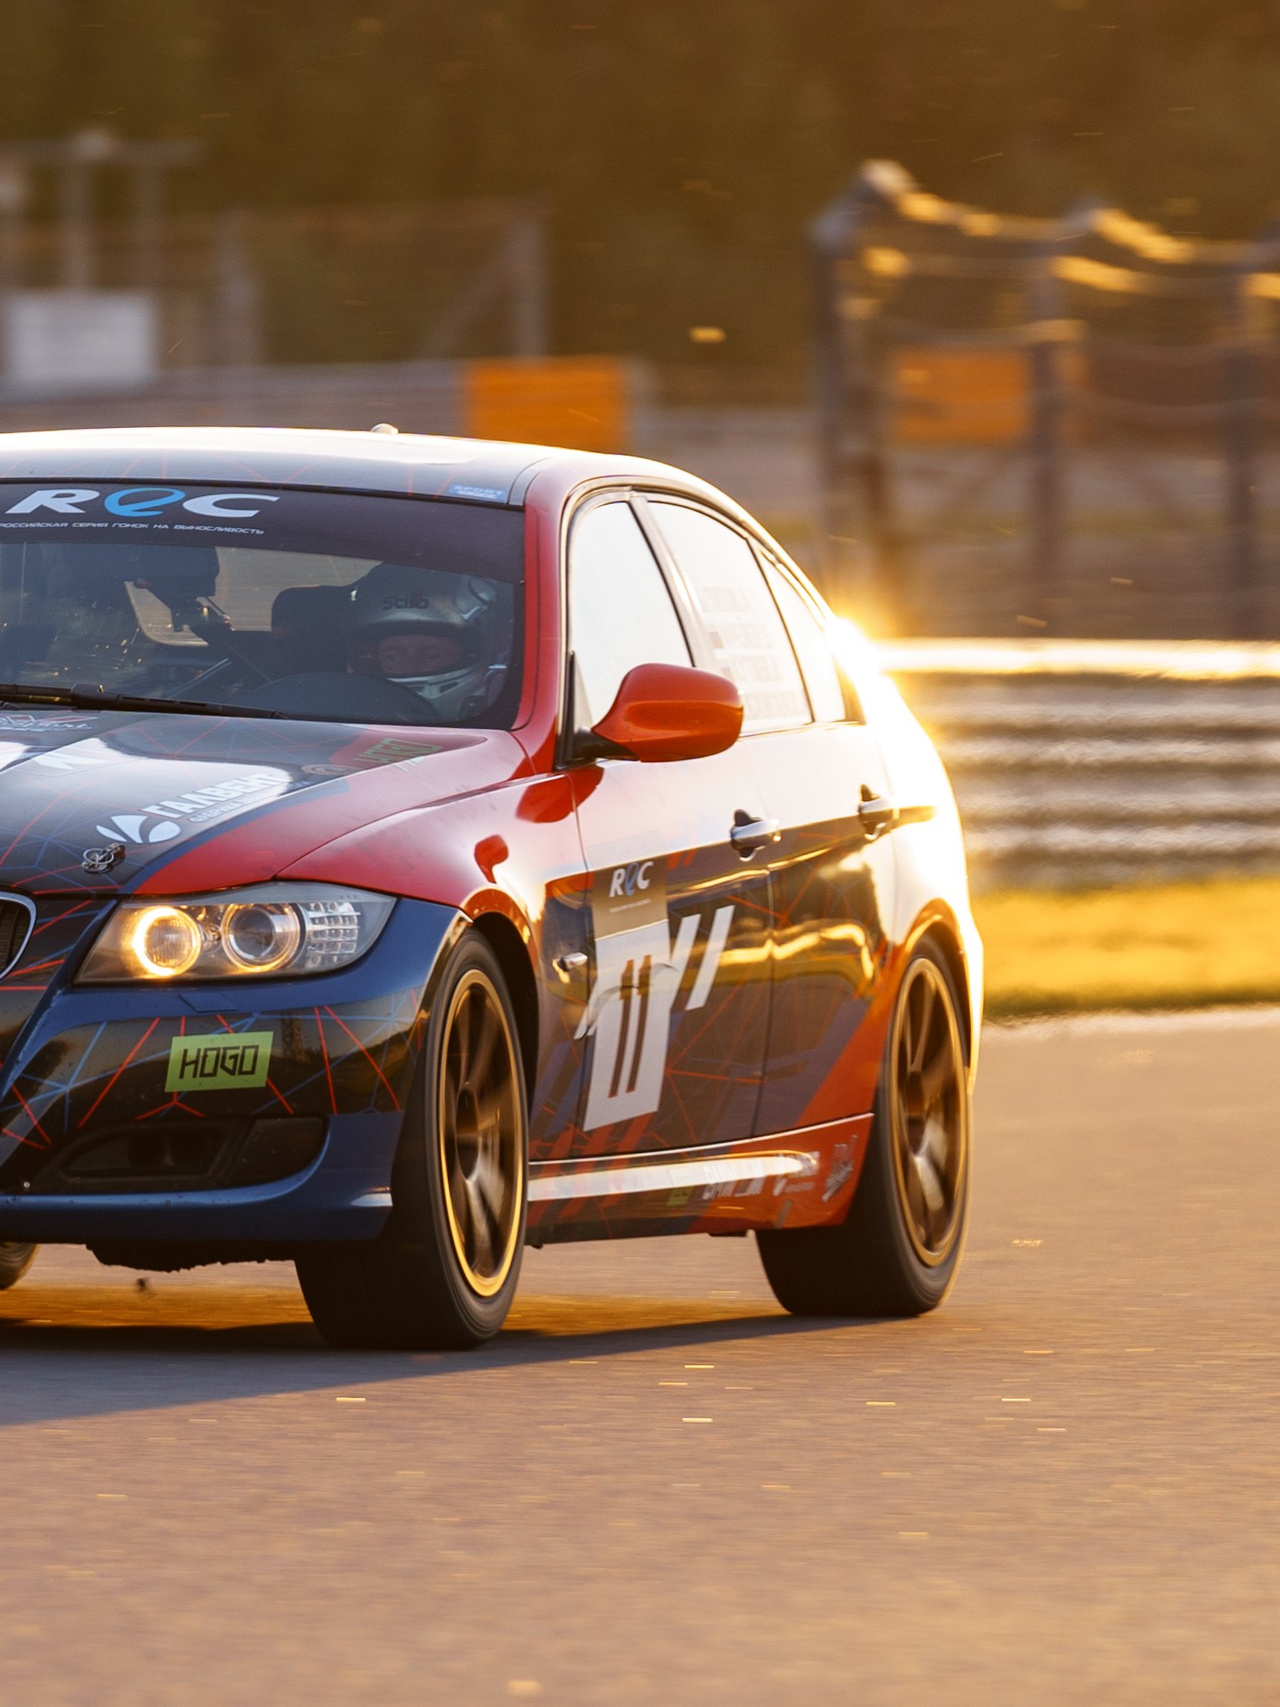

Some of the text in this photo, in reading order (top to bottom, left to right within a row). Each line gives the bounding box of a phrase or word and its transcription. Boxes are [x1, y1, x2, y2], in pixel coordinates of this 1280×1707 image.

[173, 524, 264, 535] ВЫНОСЛИВОСТЬ
[608, 954, 652, 1098] 11
[178, 1045, 259, 1079] HOGO
